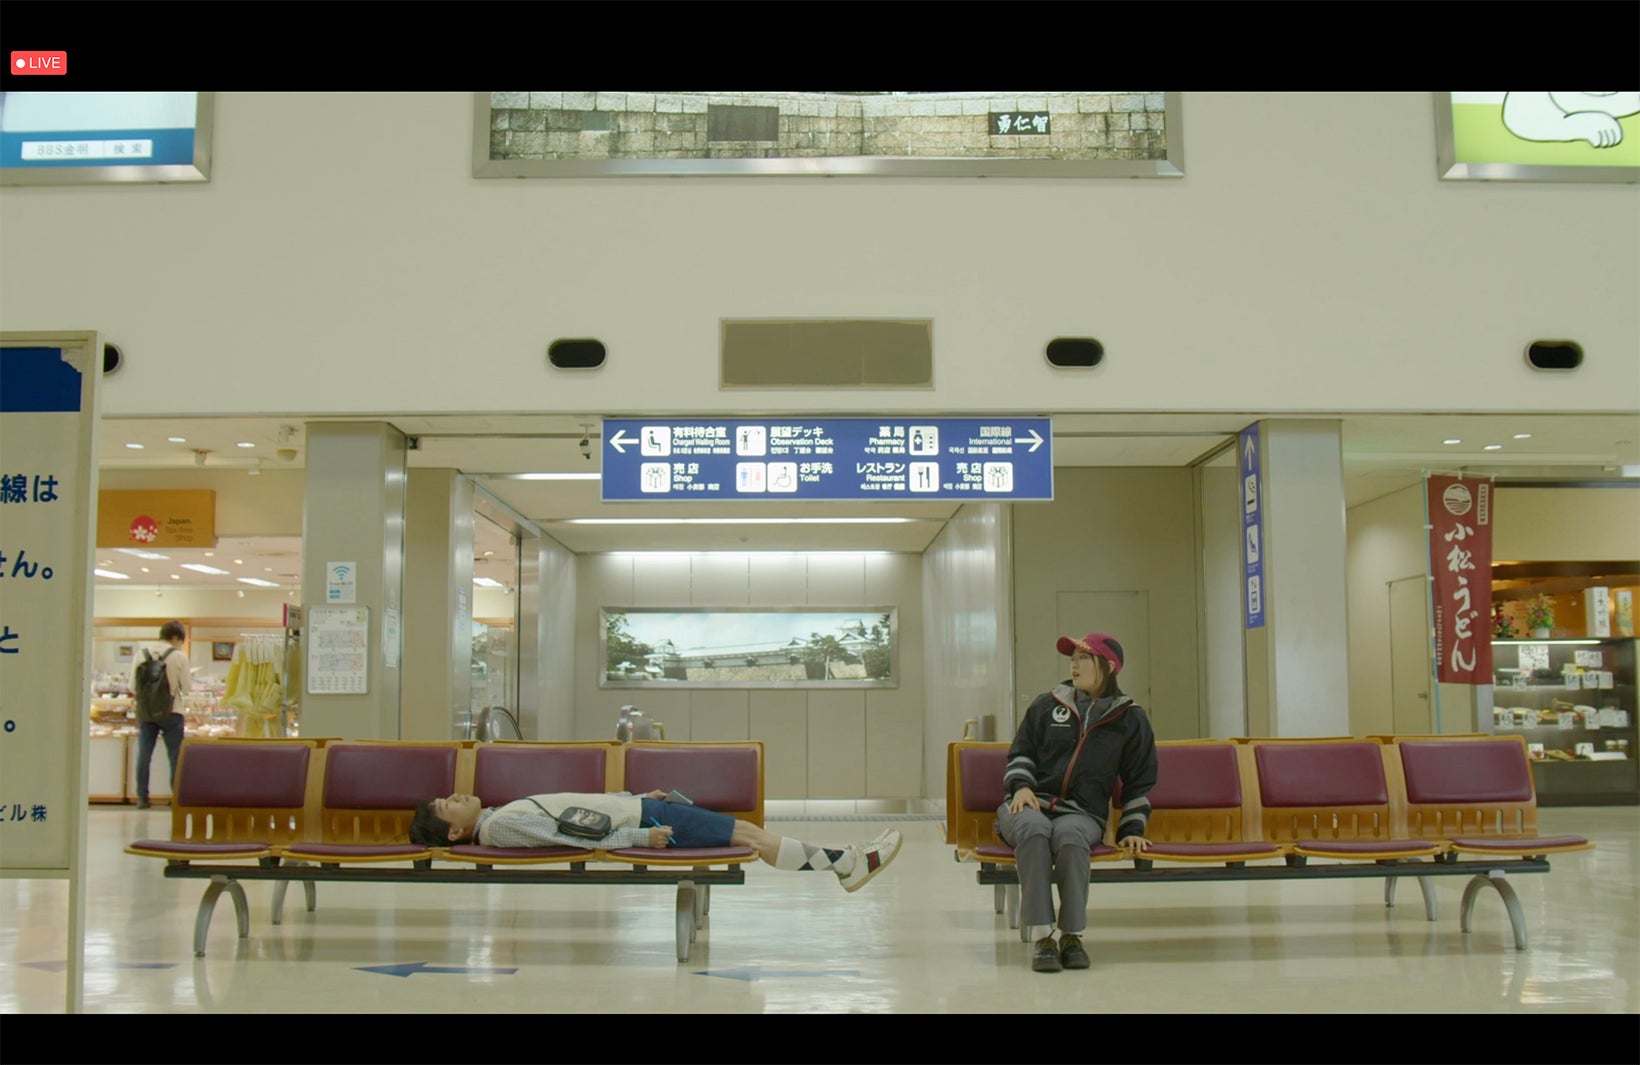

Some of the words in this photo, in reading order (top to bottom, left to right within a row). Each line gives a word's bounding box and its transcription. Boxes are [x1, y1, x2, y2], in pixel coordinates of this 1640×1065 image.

[770, 426, 824, 438] 展望デッキ
[980, 426, 1012, 438] 国際線
[770, 438, 814, 446] Observation
[814, 438, 834, 446] Deck
[869, 437, 906, 447] Pharmacy
[969, 437, 1012, 446] International
[800, 462, 833, 474] お手洗
[856, 462, 906, 474] レストラン
[673, 474, 693, 483] Shop
[800, 474, 820, 482] Toilet
[866, 474, 906, 482] Restaurant
[963, 473, 983, 483] Shop
[0, 473, 58, 503] 線は
[1444, 523, 1479, 672] 小松うどん
